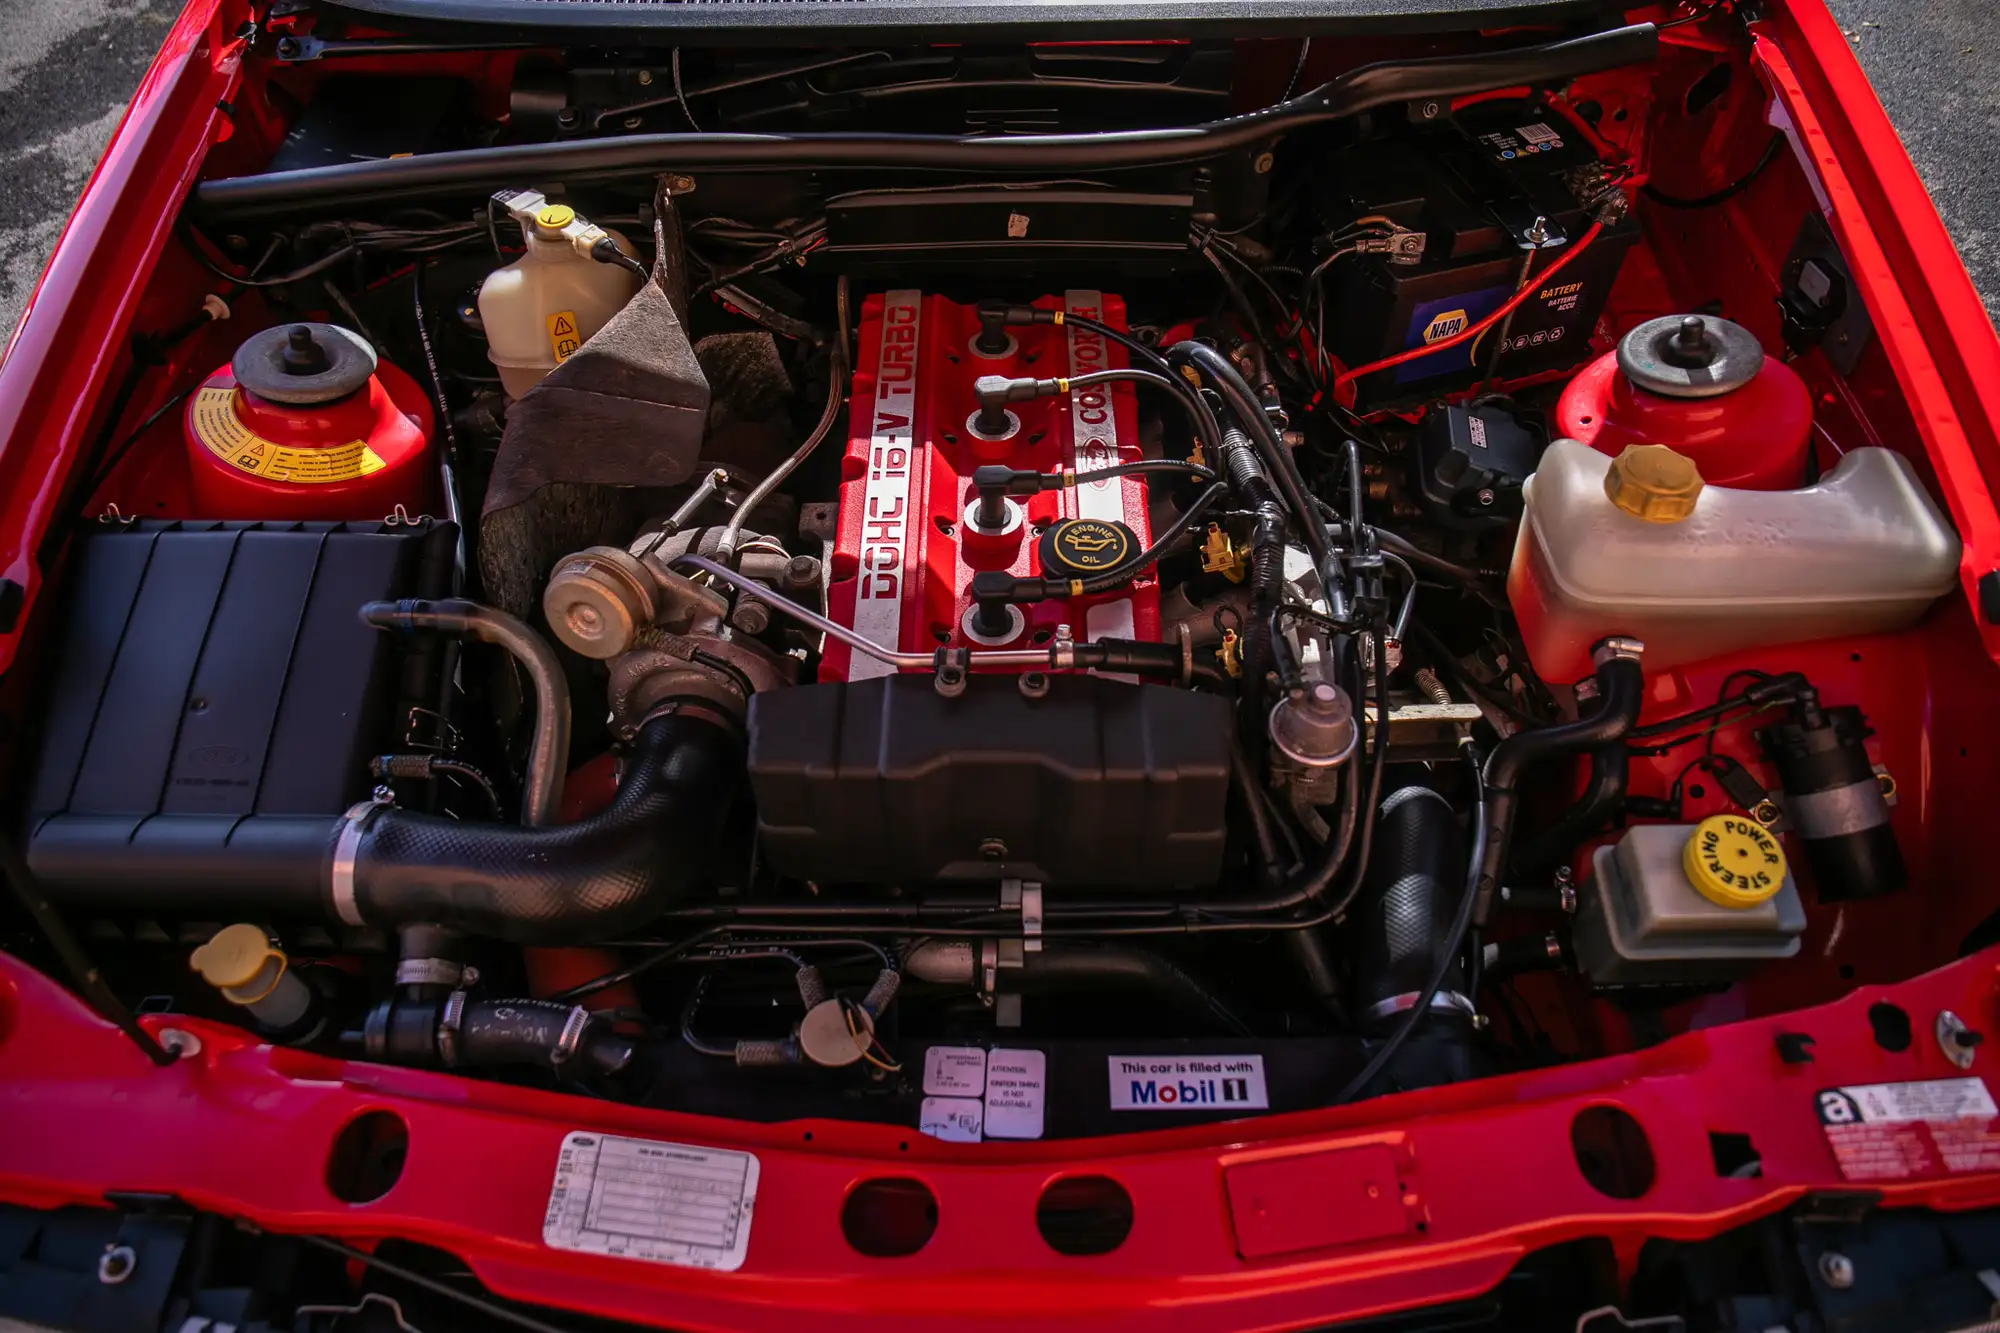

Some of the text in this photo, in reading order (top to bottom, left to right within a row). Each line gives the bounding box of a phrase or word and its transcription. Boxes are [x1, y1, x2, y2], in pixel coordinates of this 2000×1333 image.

[1540, 282, 1583, 299] BATTERY
[1547, 294, 1578, 308] BATTERIE
[1557, 302, 1576, 311] ACCU
[1429, 317, 1462, 339] NAPA
[880, 305, 916, 400] TURBO
[1071, 524, 1114, 539] ENGINE
[861, 497, 903, 599] DOHC
[1081, 555, 1101, 564] OIL
[1702, 820, 1779, 889] POWER STEERING
[1121, 1061, 1253, 1073] This car is filled with
[1130, 1078, 1244, 1103] Mobil 1
